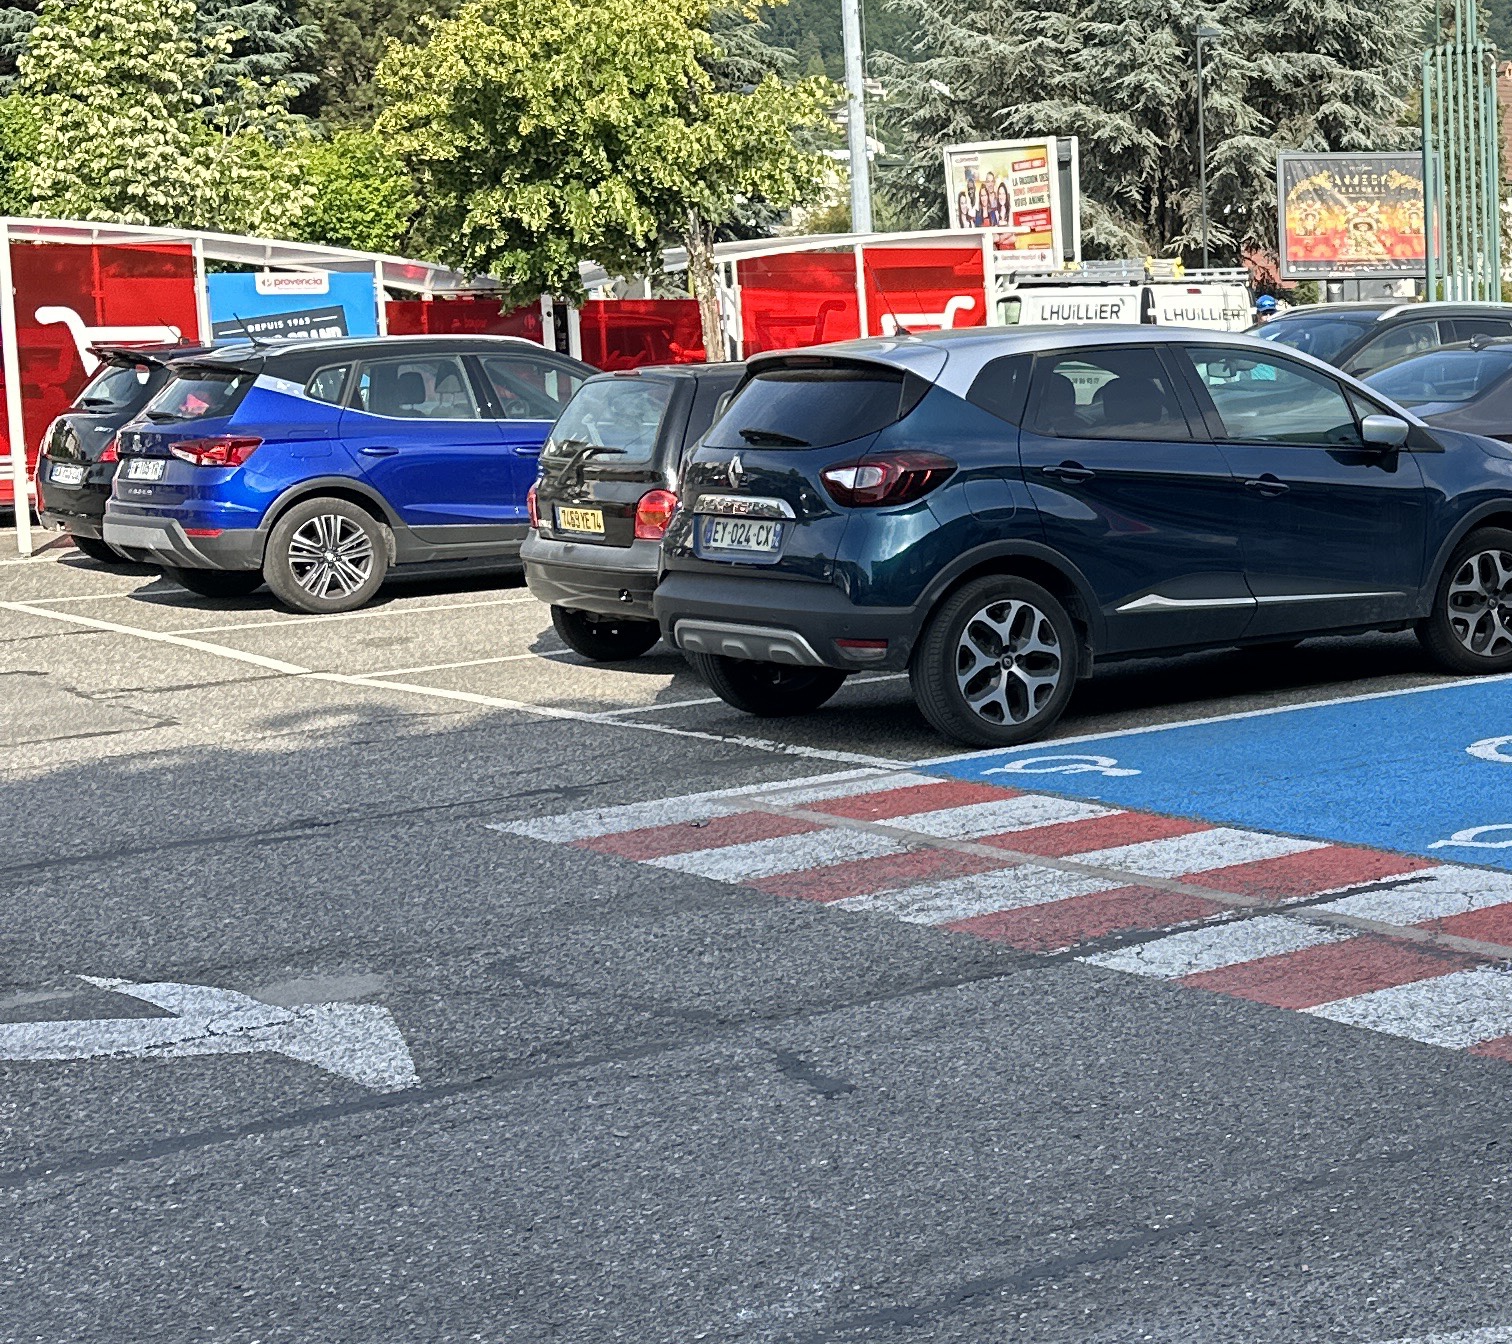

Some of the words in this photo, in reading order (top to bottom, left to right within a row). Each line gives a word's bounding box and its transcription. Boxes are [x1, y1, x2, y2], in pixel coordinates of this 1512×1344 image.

[274, 278, 323, 287] provencia
[247, 321, 284, 332] DEPUIS
[712, 521, 773, 547] EY-024-CX
